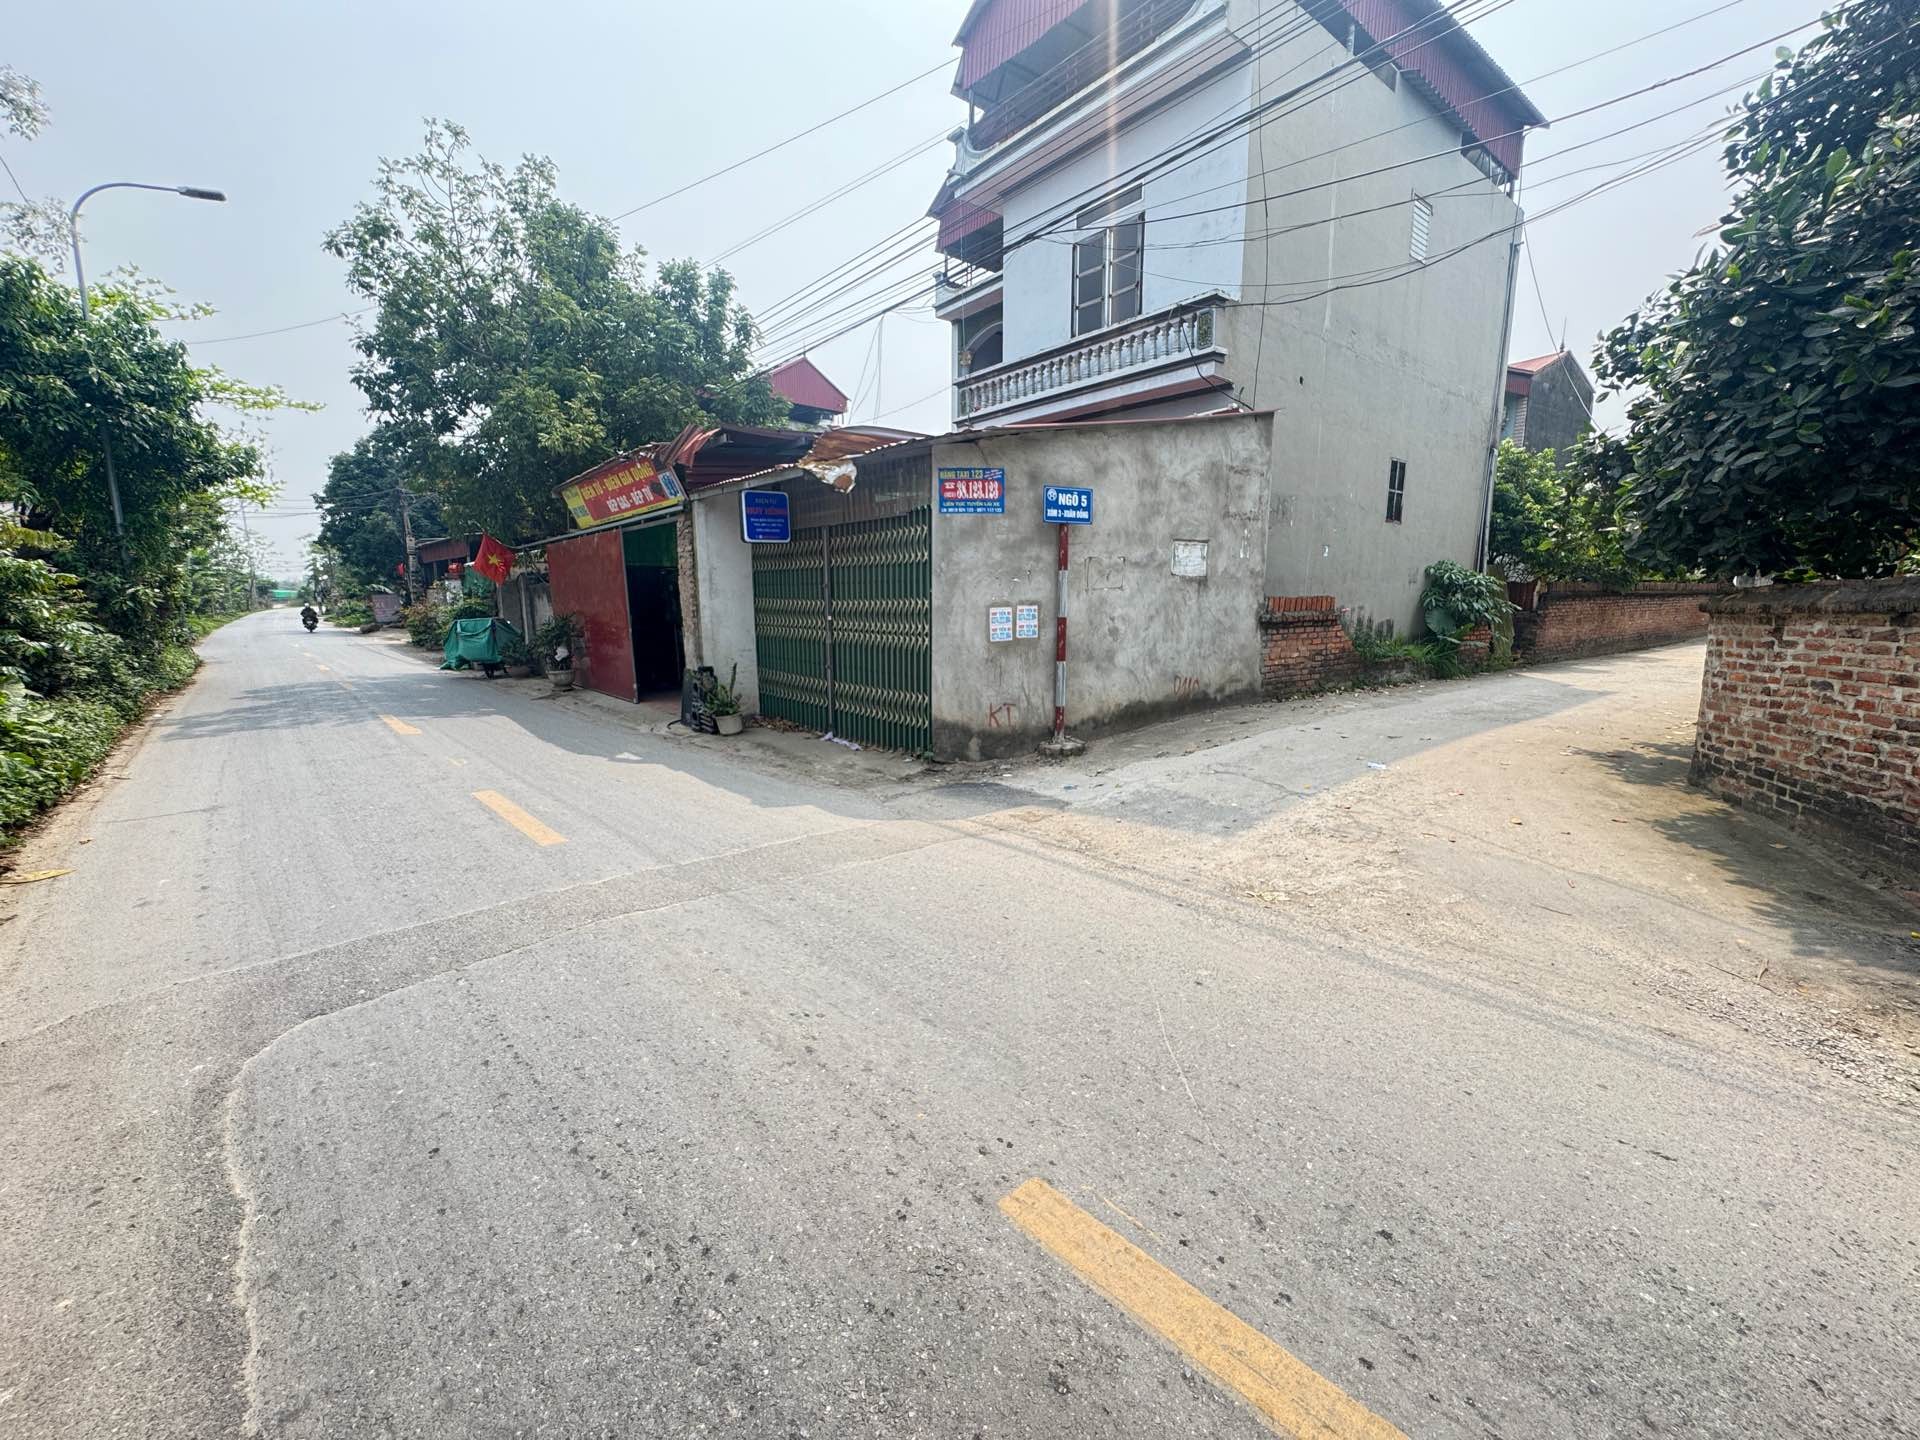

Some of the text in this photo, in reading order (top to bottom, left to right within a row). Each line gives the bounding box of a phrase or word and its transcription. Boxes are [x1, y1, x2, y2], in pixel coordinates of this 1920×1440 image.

[957, 470, 970, 479] TAXI
[1058, 491, 1088, 507] NGÕ 5
